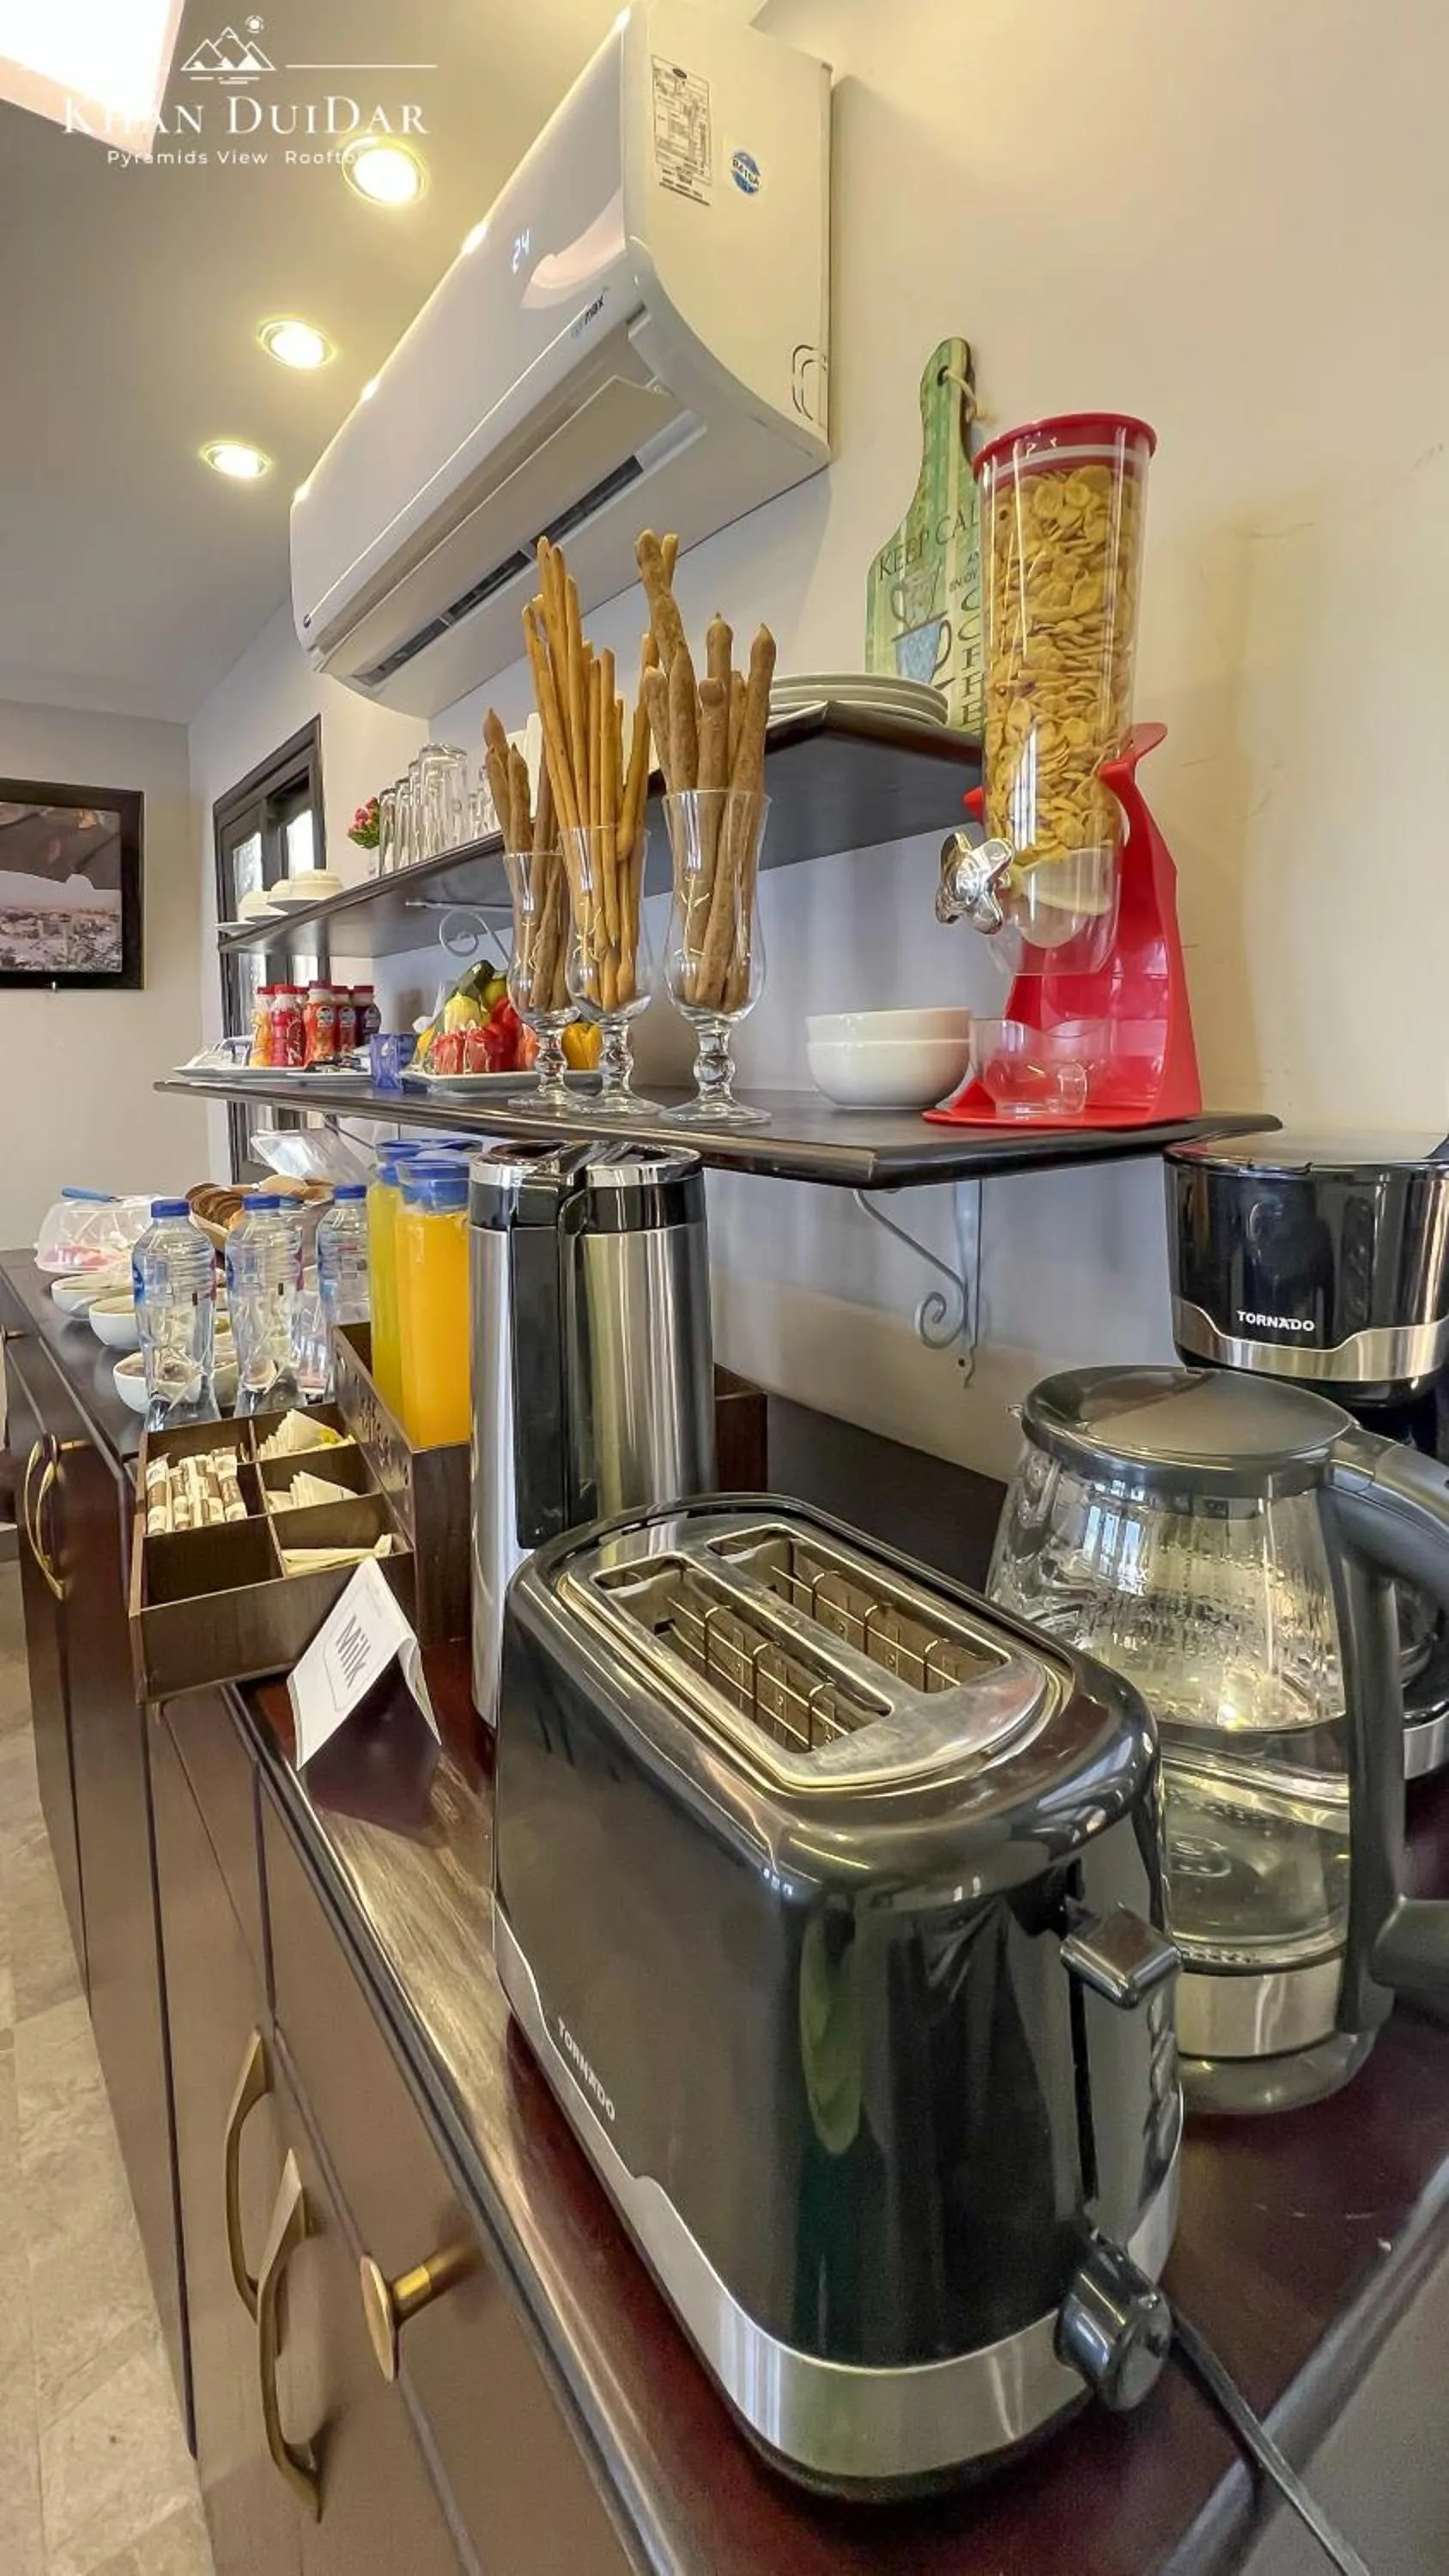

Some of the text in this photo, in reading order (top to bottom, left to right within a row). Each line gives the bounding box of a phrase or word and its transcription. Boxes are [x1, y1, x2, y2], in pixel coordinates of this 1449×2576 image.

[512, 227, 530, 274] 24
[878, 499, 979, 581] KEEP CAL
[1236, 1309, 1316, 1332] TORNADO
[335, 1613, 371, 1689] Milk
[557, 2015, 615, 2122] TORNADO
